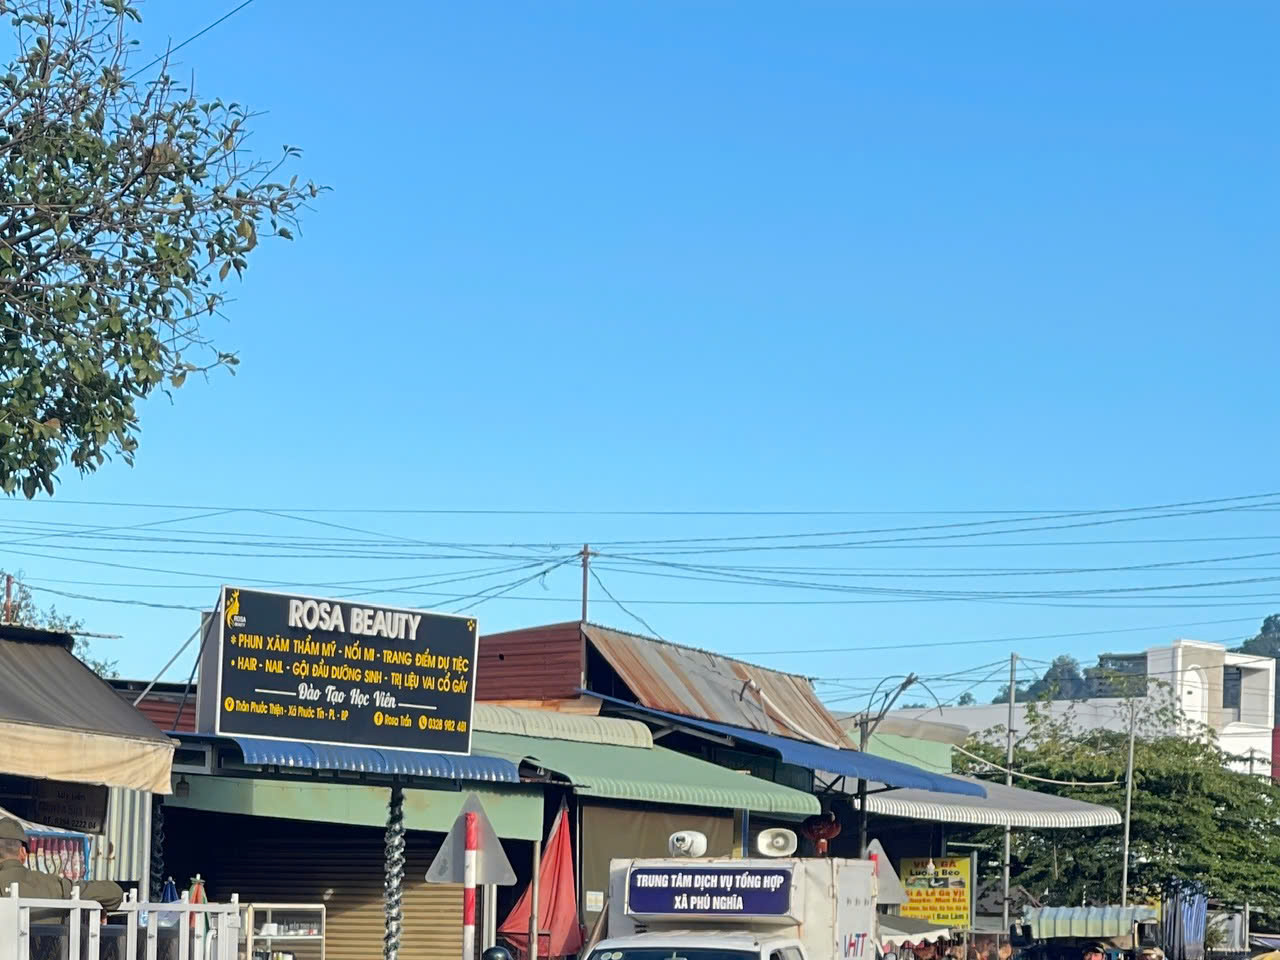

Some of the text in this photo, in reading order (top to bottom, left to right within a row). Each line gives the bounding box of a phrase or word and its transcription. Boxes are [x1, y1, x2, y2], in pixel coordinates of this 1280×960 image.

[288, 599, 421, 640] ROSA BEAUTY
[238, 633, 263, 650] PHUN
[293, 634, 320, 656] THẨM
[344, 640, 362, 660] NỐI
[363, 647, 375, 661] MI
[382, 649, 413, 666] TRANG
[415, 648, 436, 669] ĐIỂM
[452, 655, 470, 674] TIỆC
[237, 656, 258, 671] HAIR
[265, 659, 284, 674] NAIL
[292, 660, 310, 679] GỘI
[364, 670, 383, 685] SINH
[391, 672, 403, 690] TRỊ
[404, 671, 420, 691] LIỆU
[422, 675, 436, 690] VAI
[437, 671, 451, 692] CỔ
[452, 675, 469, 694] GÁY
[298, 682, 397, 709] Đào Tạo Học Viên
[384, 714, 399, 726] Rosa
[637, 871, 784, 892] TRUNG TÂM DỊCH VỤ TỔNG HỢP
[674, 894, 743, 910] XÃ PHÚ NGHĨA
